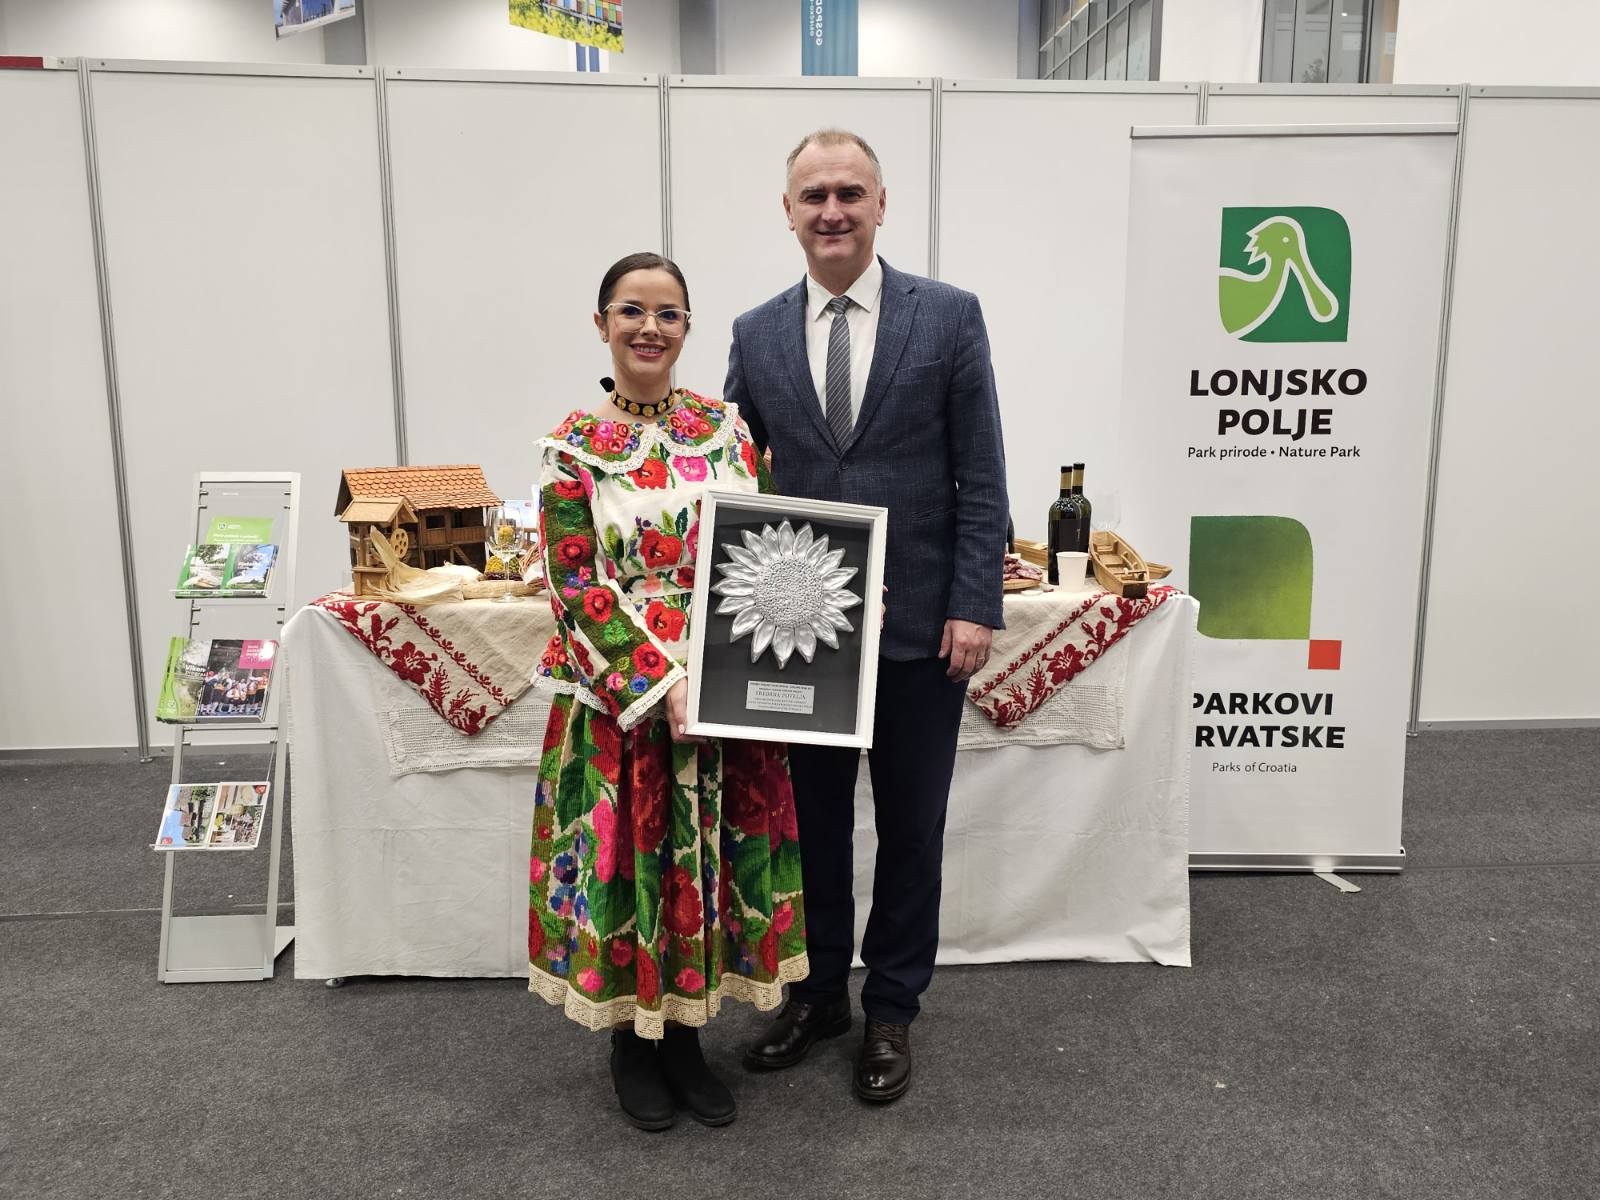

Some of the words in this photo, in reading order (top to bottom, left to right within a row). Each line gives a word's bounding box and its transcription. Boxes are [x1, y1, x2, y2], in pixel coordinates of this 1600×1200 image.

[1190, 369, 1367, 402] LONJSKO
[1218, 409, 1332, 441] POLJE
[1188, 446, 1216, 457] Park
[1220, 446, 1266, 460] prirode
[1279, 447, 1326, 457] Nature
[1331, 446, 1360, 457] Park
[1195, 726, 1345, 748] RVATSKE
[1213, 762, 1240, 772] Parks
[1245, 762, 1256, 772] of
[1258, 763, 1296, 772] Croatia
